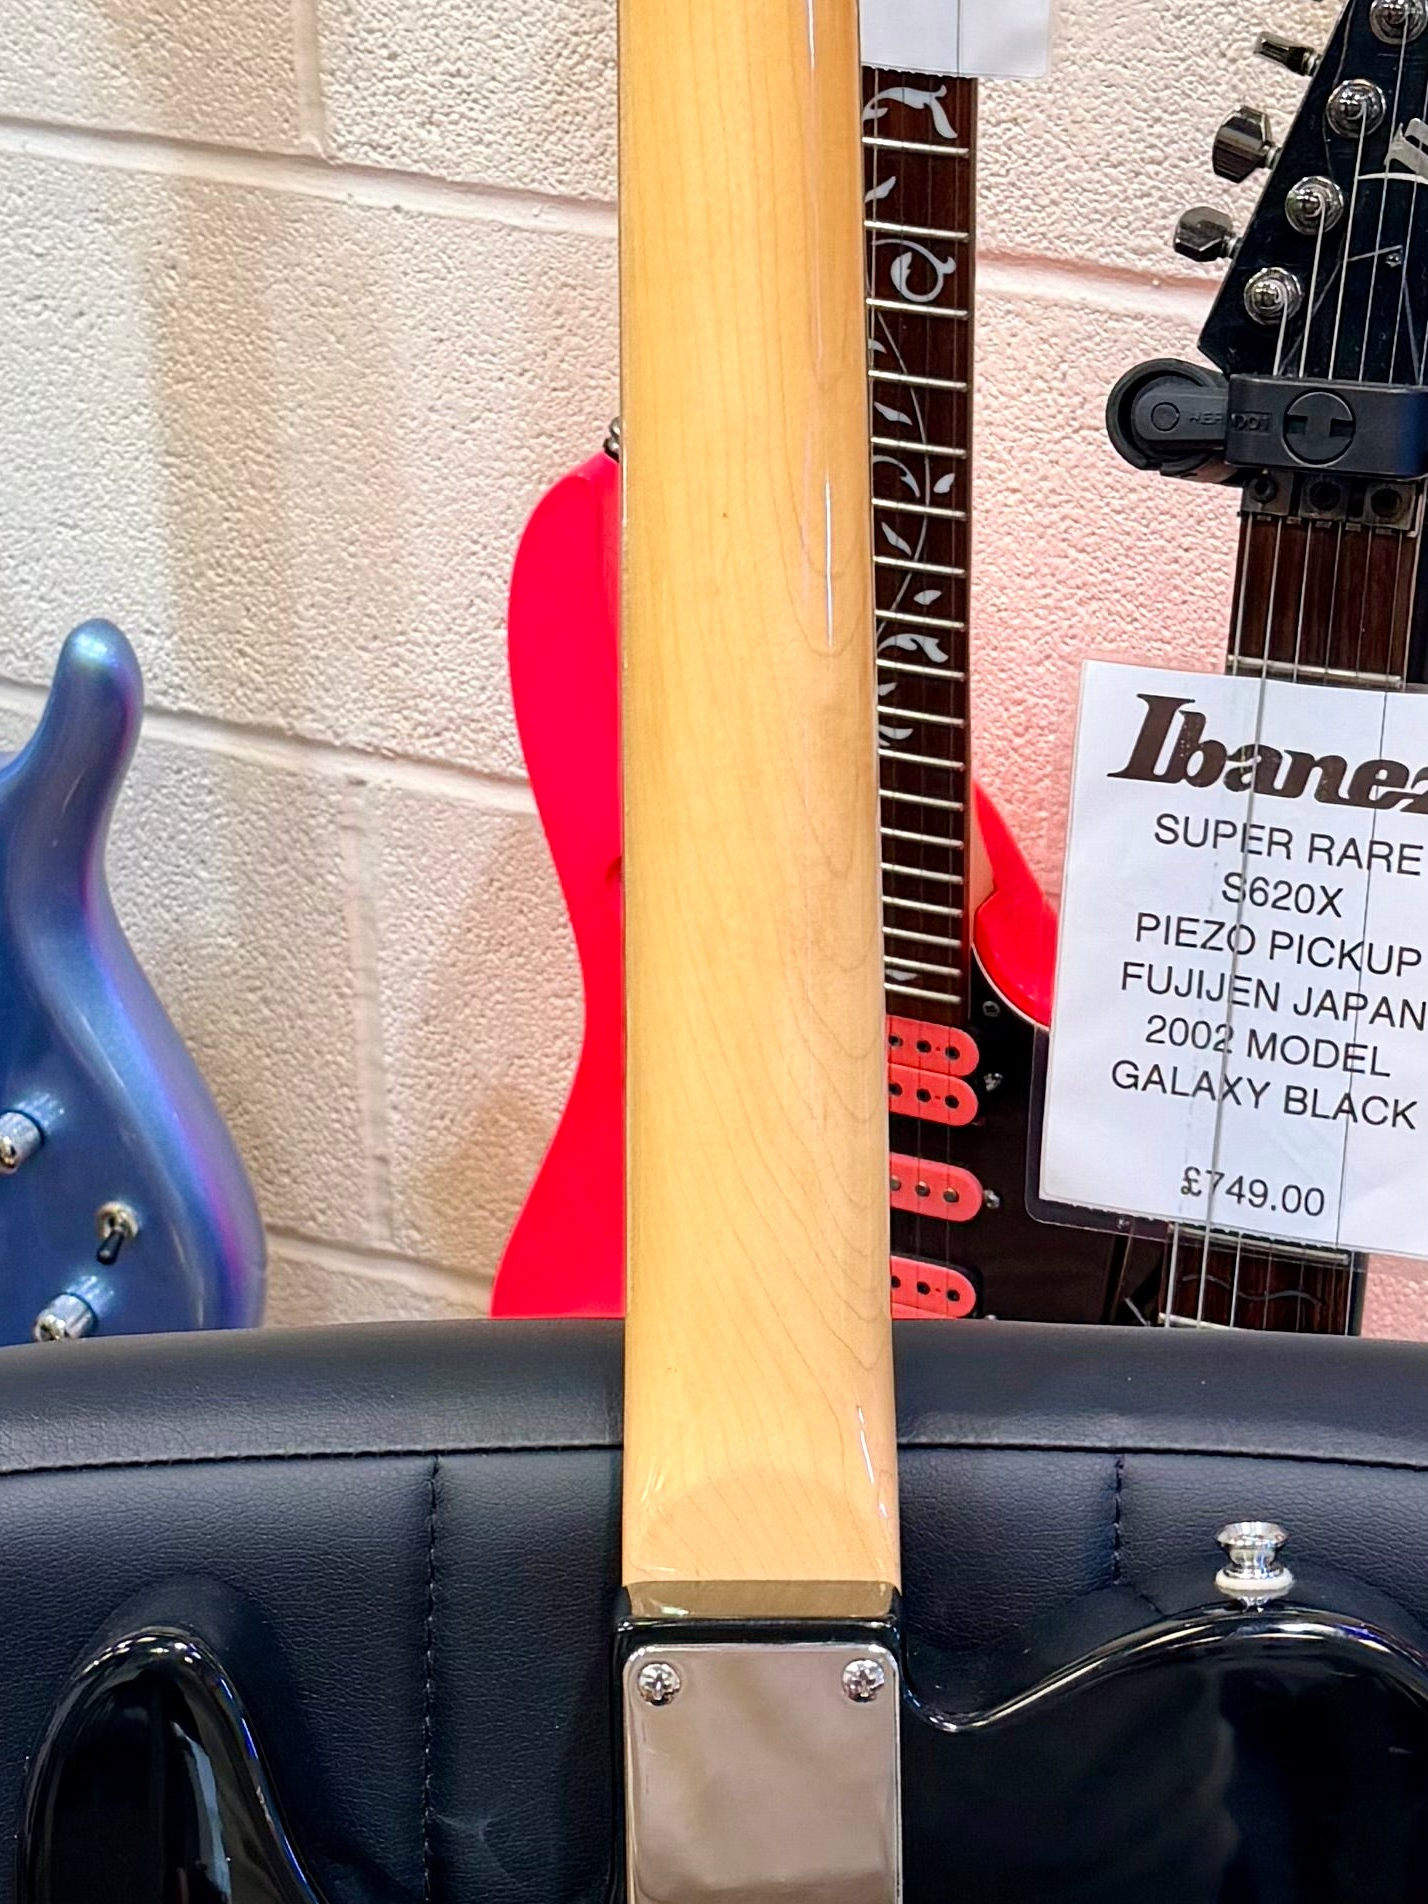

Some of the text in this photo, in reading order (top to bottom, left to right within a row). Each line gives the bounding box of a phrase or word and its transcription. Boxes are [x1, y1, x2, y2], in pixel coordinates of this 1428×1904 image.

[1154, 813, 1425, 877] SUPER RARE
[1222, 873, 1343, 918] S620X
[1136, 912, 1422, 978] PIEZO PICKUP
[1122, 961, 1427, 1032] FUJIJEN JAPAN
[1145, 1014, 1392, 1078] 2002 MODEL
[1111, 1059, 1420, 1131] GALAXY BLACK
[1180, 1165, 1325, 1218] £749.00
